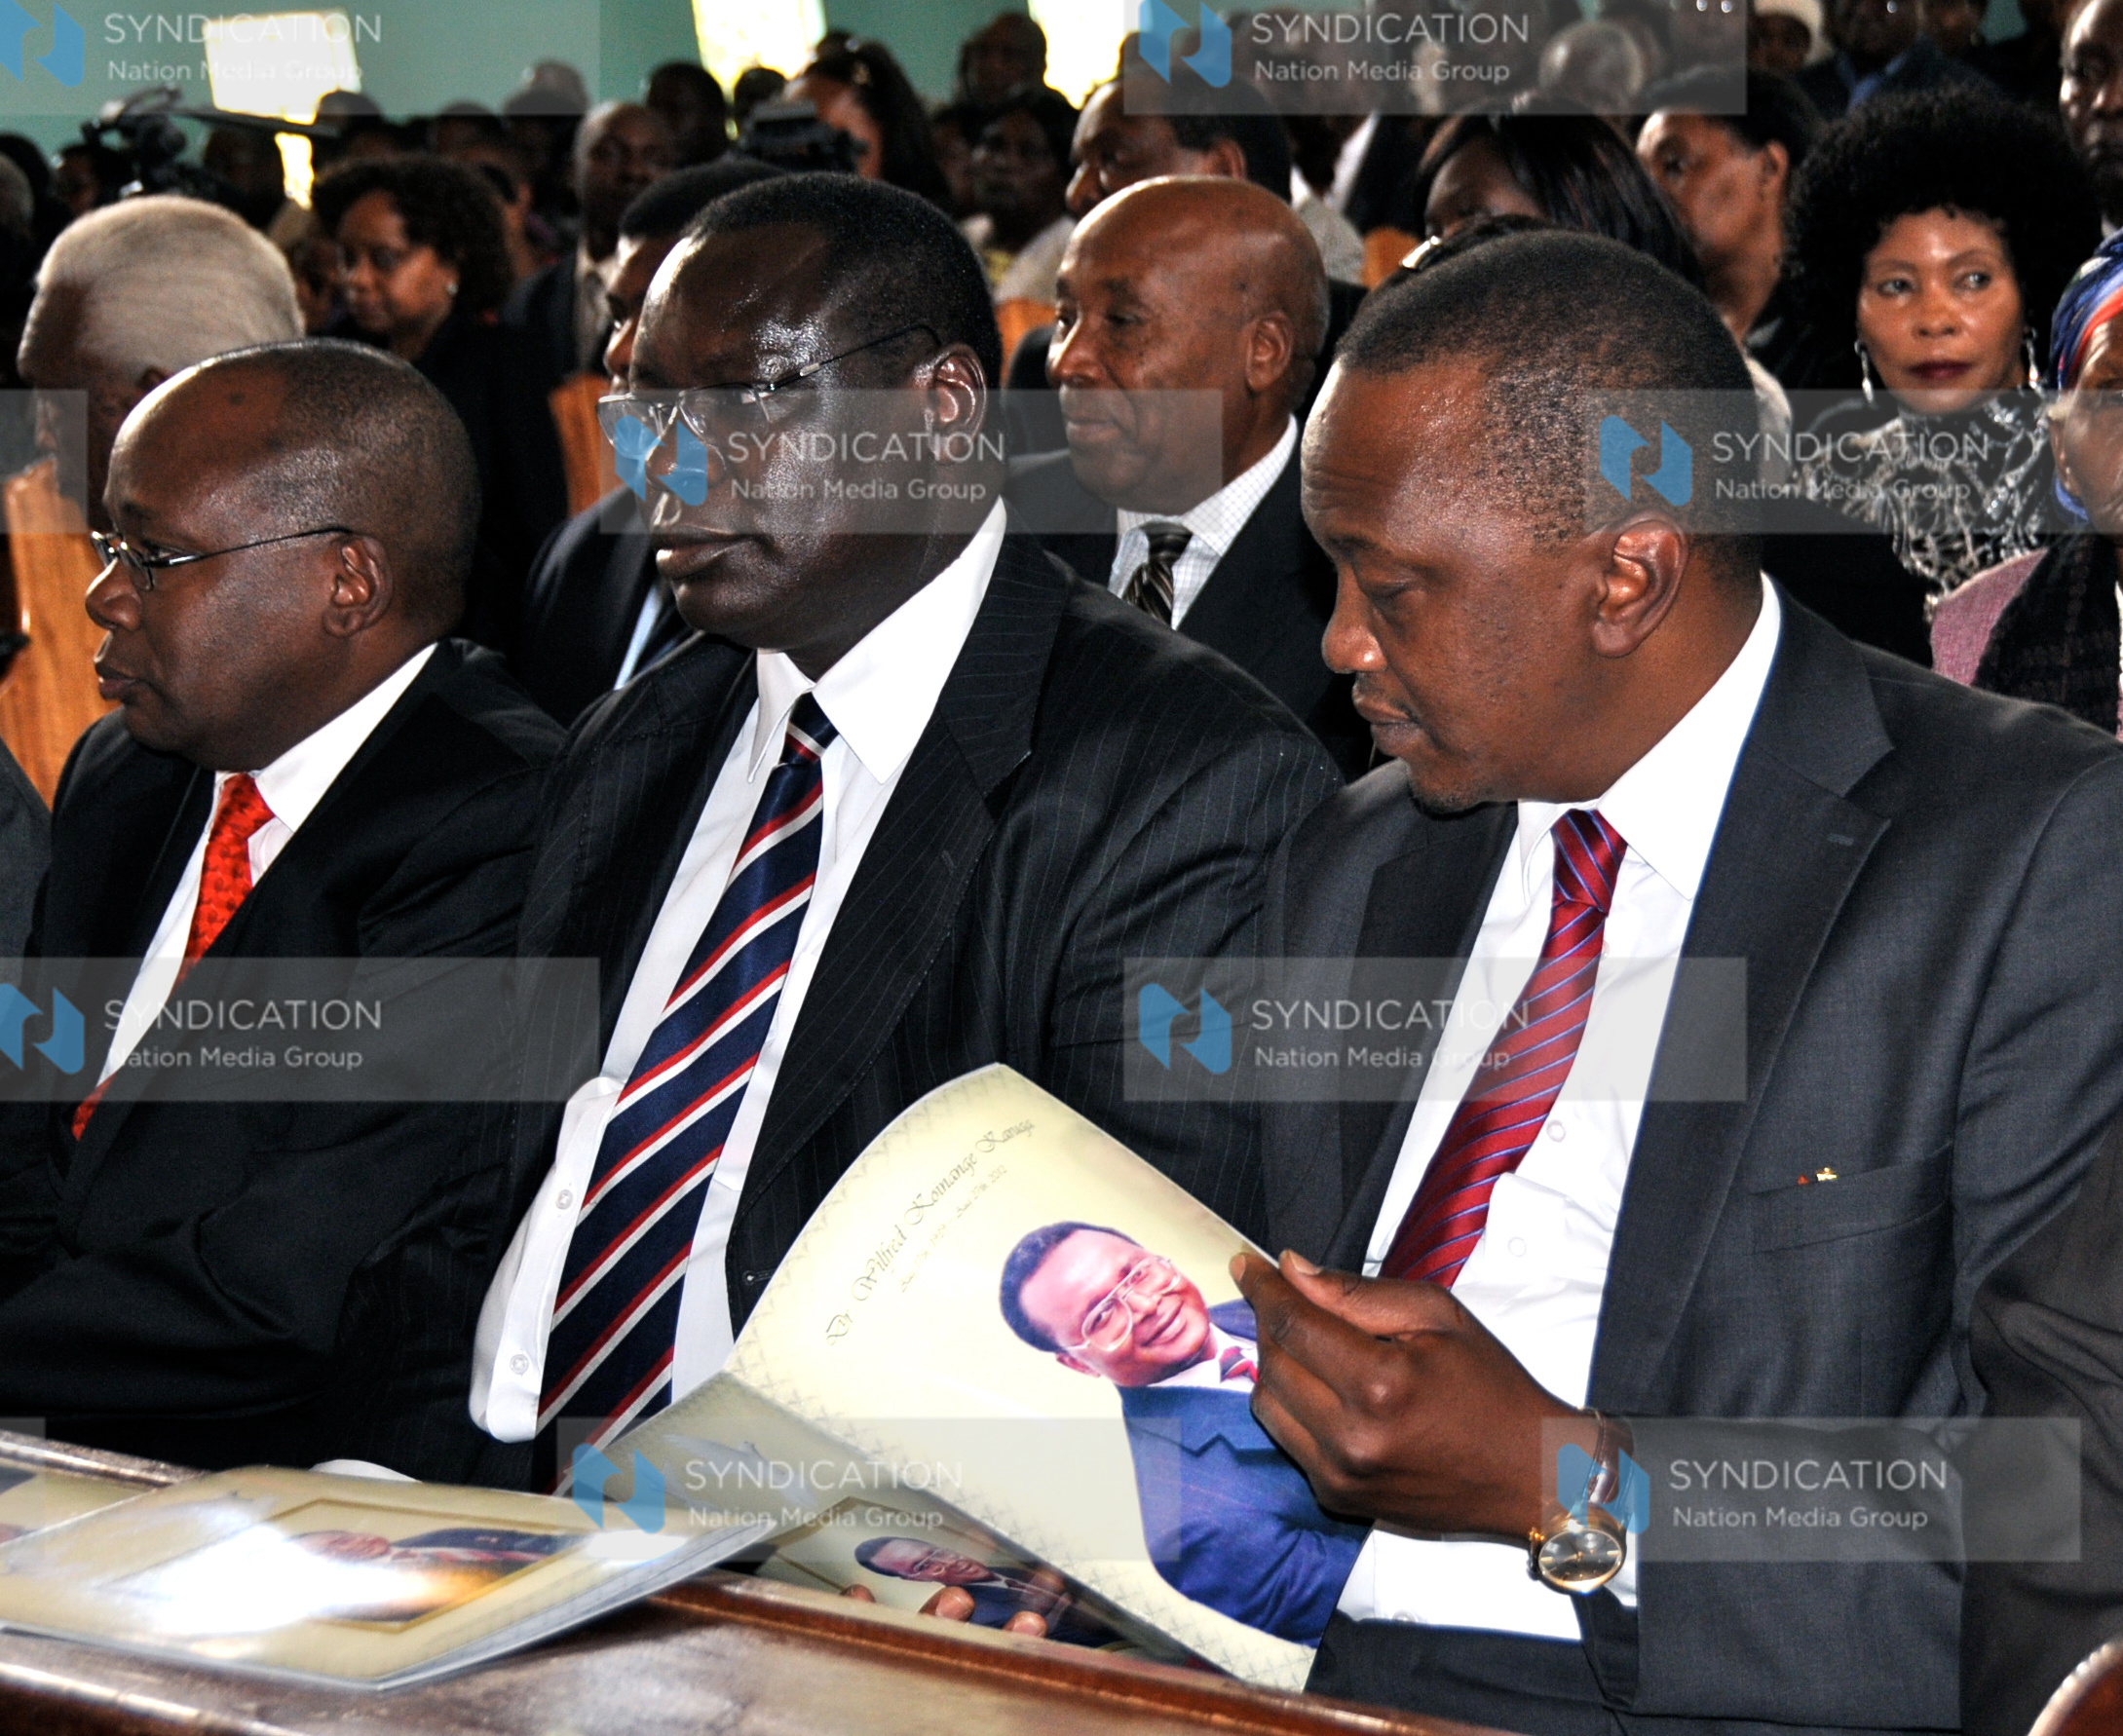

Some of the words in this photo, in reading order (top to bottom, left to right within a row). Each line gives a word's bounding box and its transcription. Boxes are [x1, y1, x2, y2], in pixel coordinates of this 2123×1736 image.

[987, 1164, 1008, 1185] 2012
[825, 1309, 853, 1346] Dr
[851, 1224, 907, 1302] Wilfred
[903, 1152, 978, 1226] Koinange
